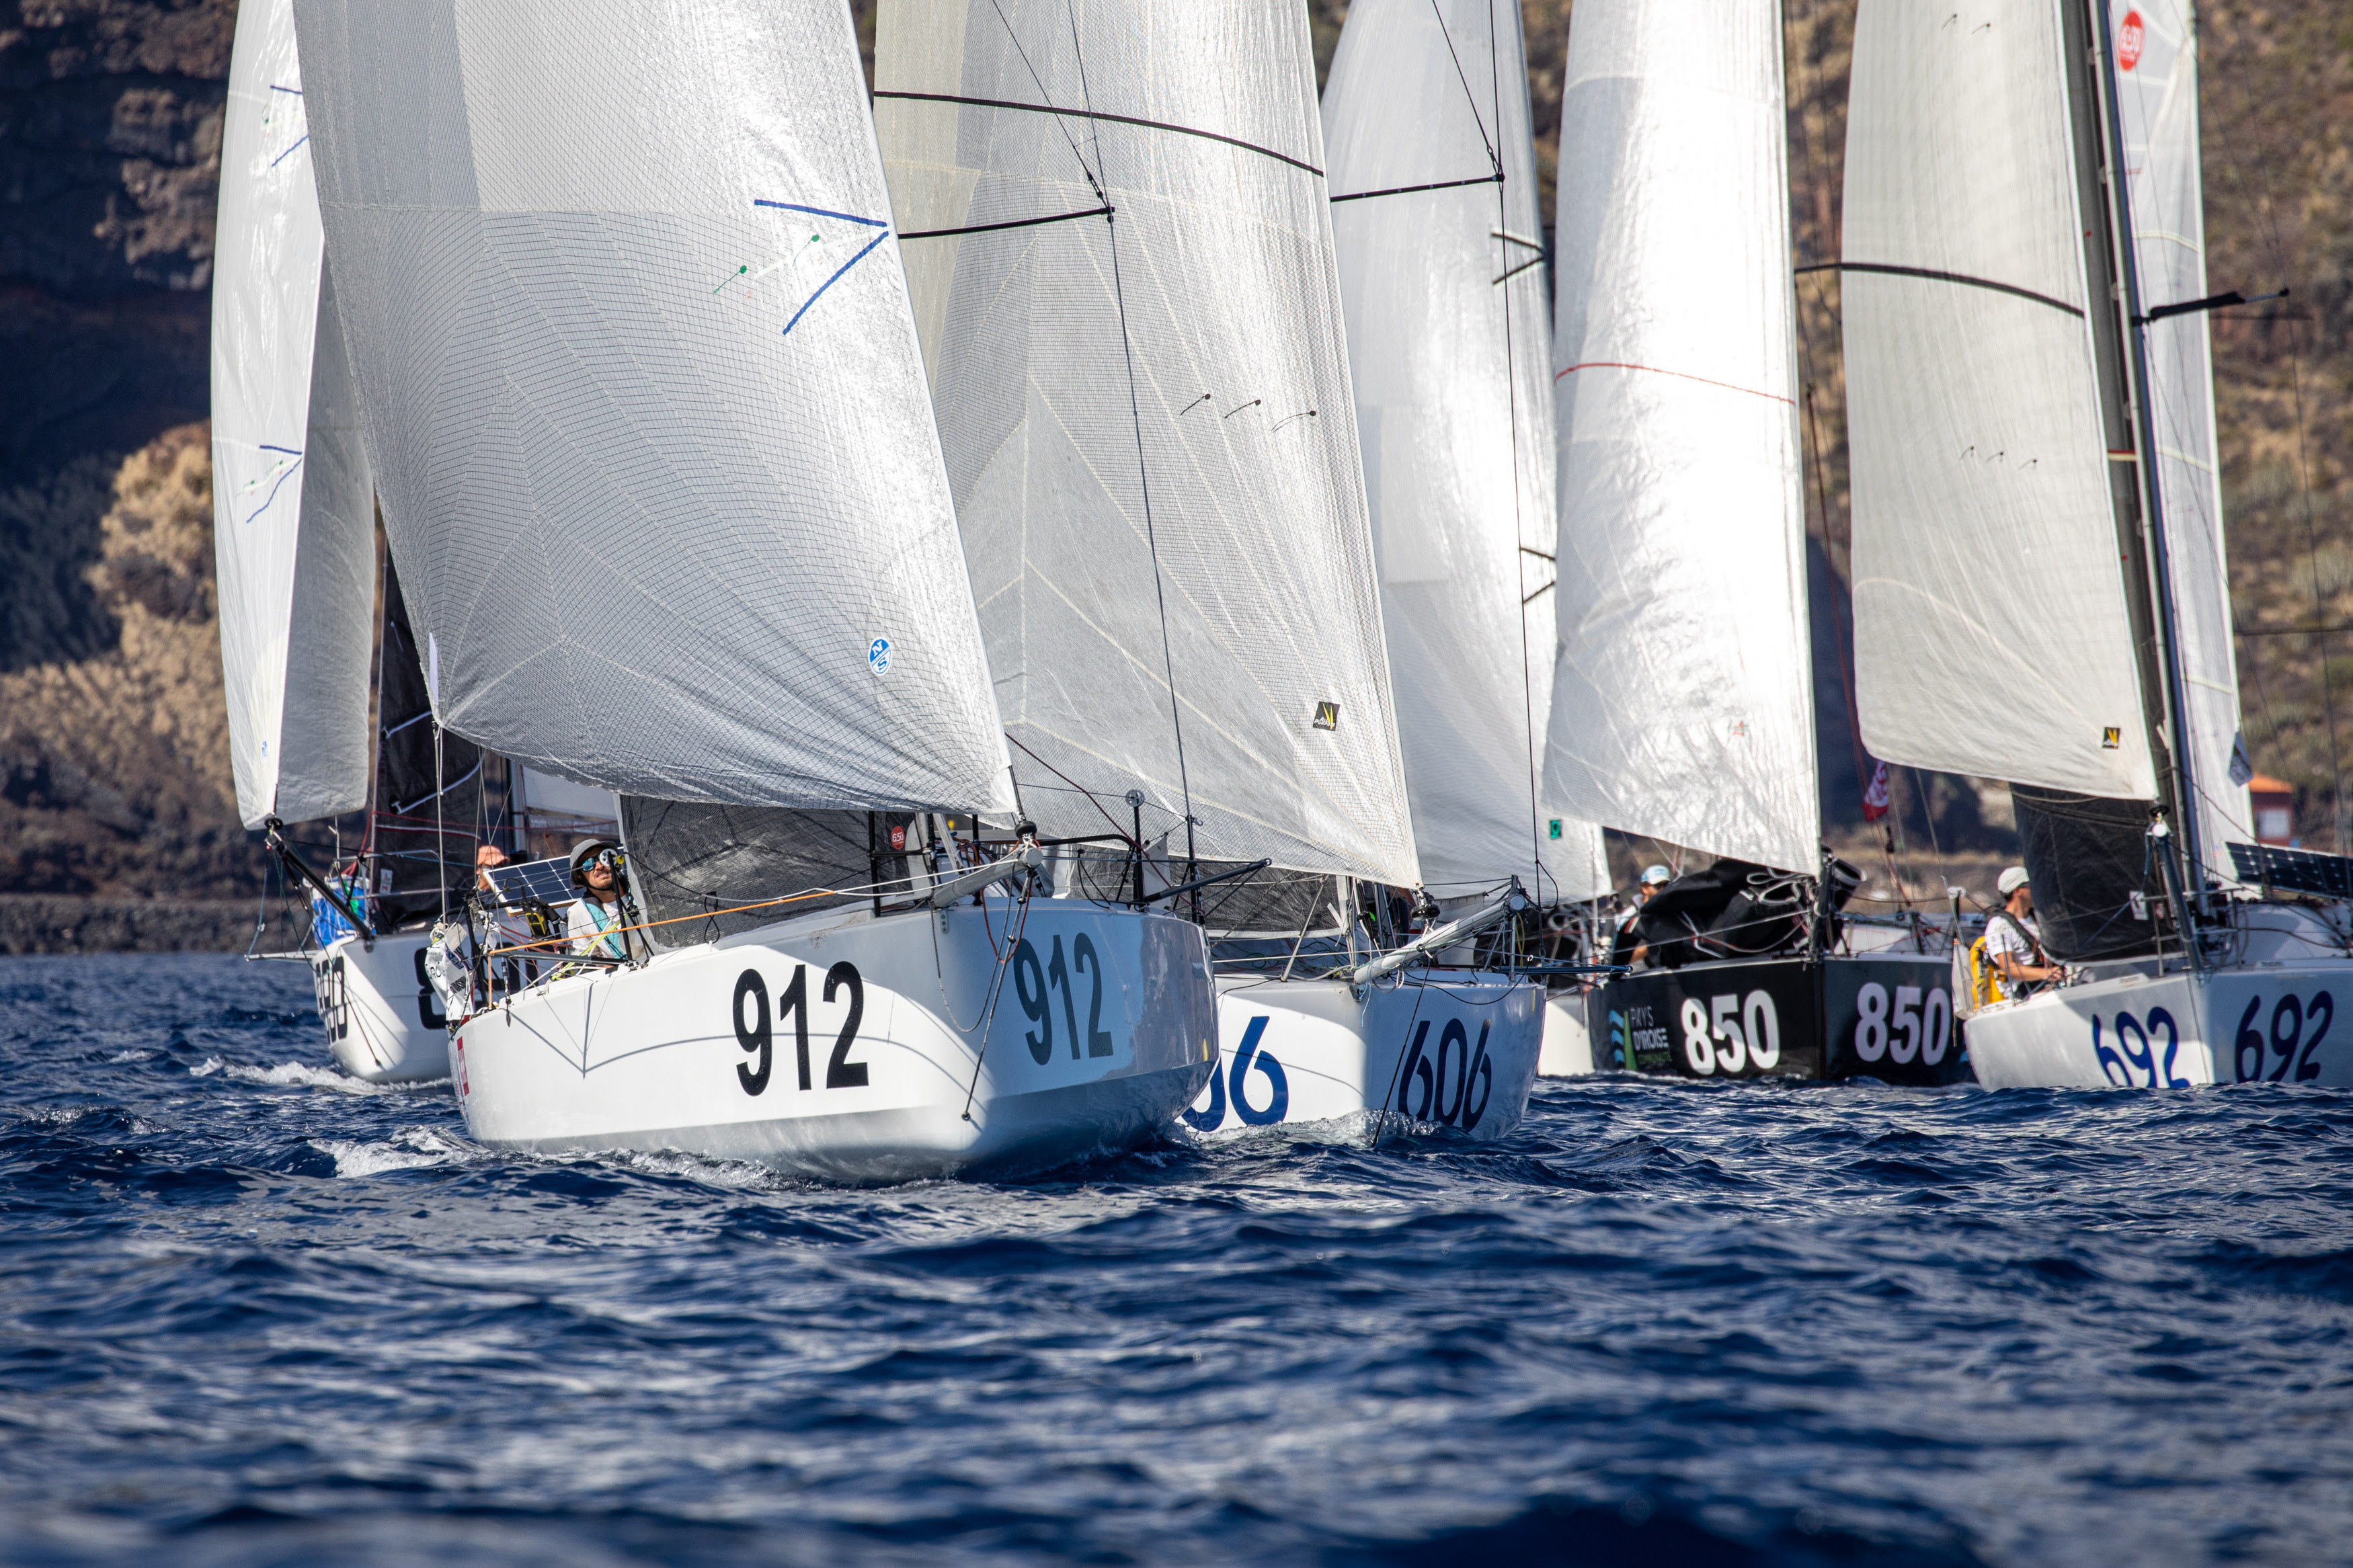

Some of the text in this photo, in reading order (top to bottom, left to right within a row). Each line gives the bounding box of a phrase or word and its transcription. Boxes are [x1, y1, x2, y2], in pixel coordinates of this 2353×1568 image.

[732, 961, 869, 1097] 912
[1014, 932, 1113, 1065] 912
[1681, 989, 1780, 1075] 850
[1855, 982, 1950, 1066] 850
[2235, 991, 2334, 1083] 692
[1398, 1018, 1492, 1133] 606
[2092, 1007, 2191, 1089] 692
